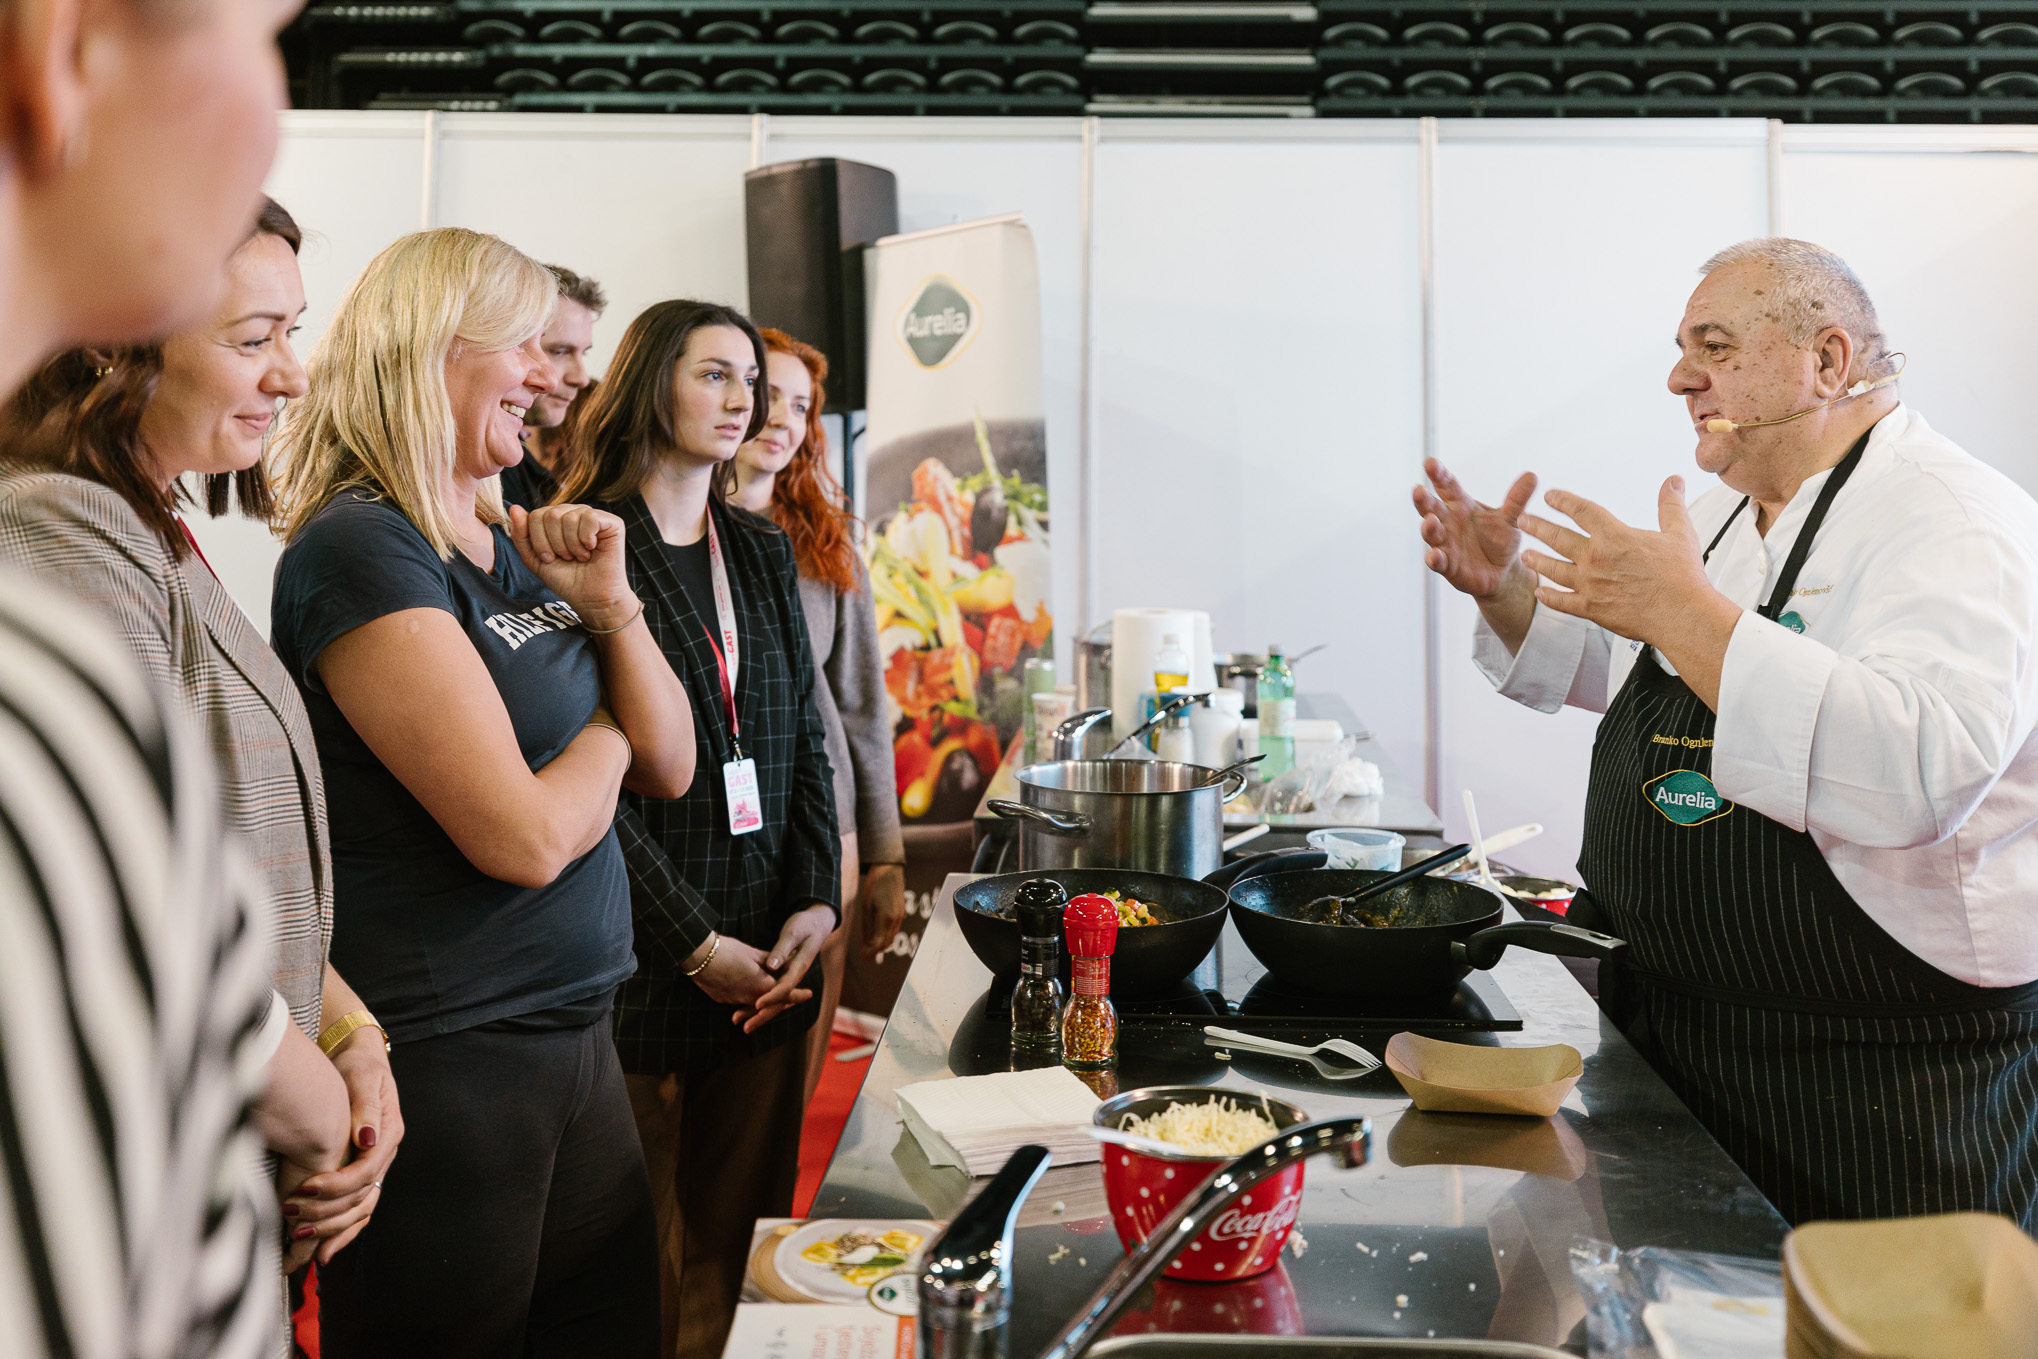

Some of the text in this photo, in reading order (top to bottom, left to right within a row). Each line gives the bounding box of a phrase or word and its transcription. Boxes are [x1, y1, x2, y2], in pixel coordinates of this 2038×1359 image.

[906, 306, 968, 338] Aurelia
[1652, 733, 1679, 746] Branko
[1654, 786, 1717, 810] Aurelia
